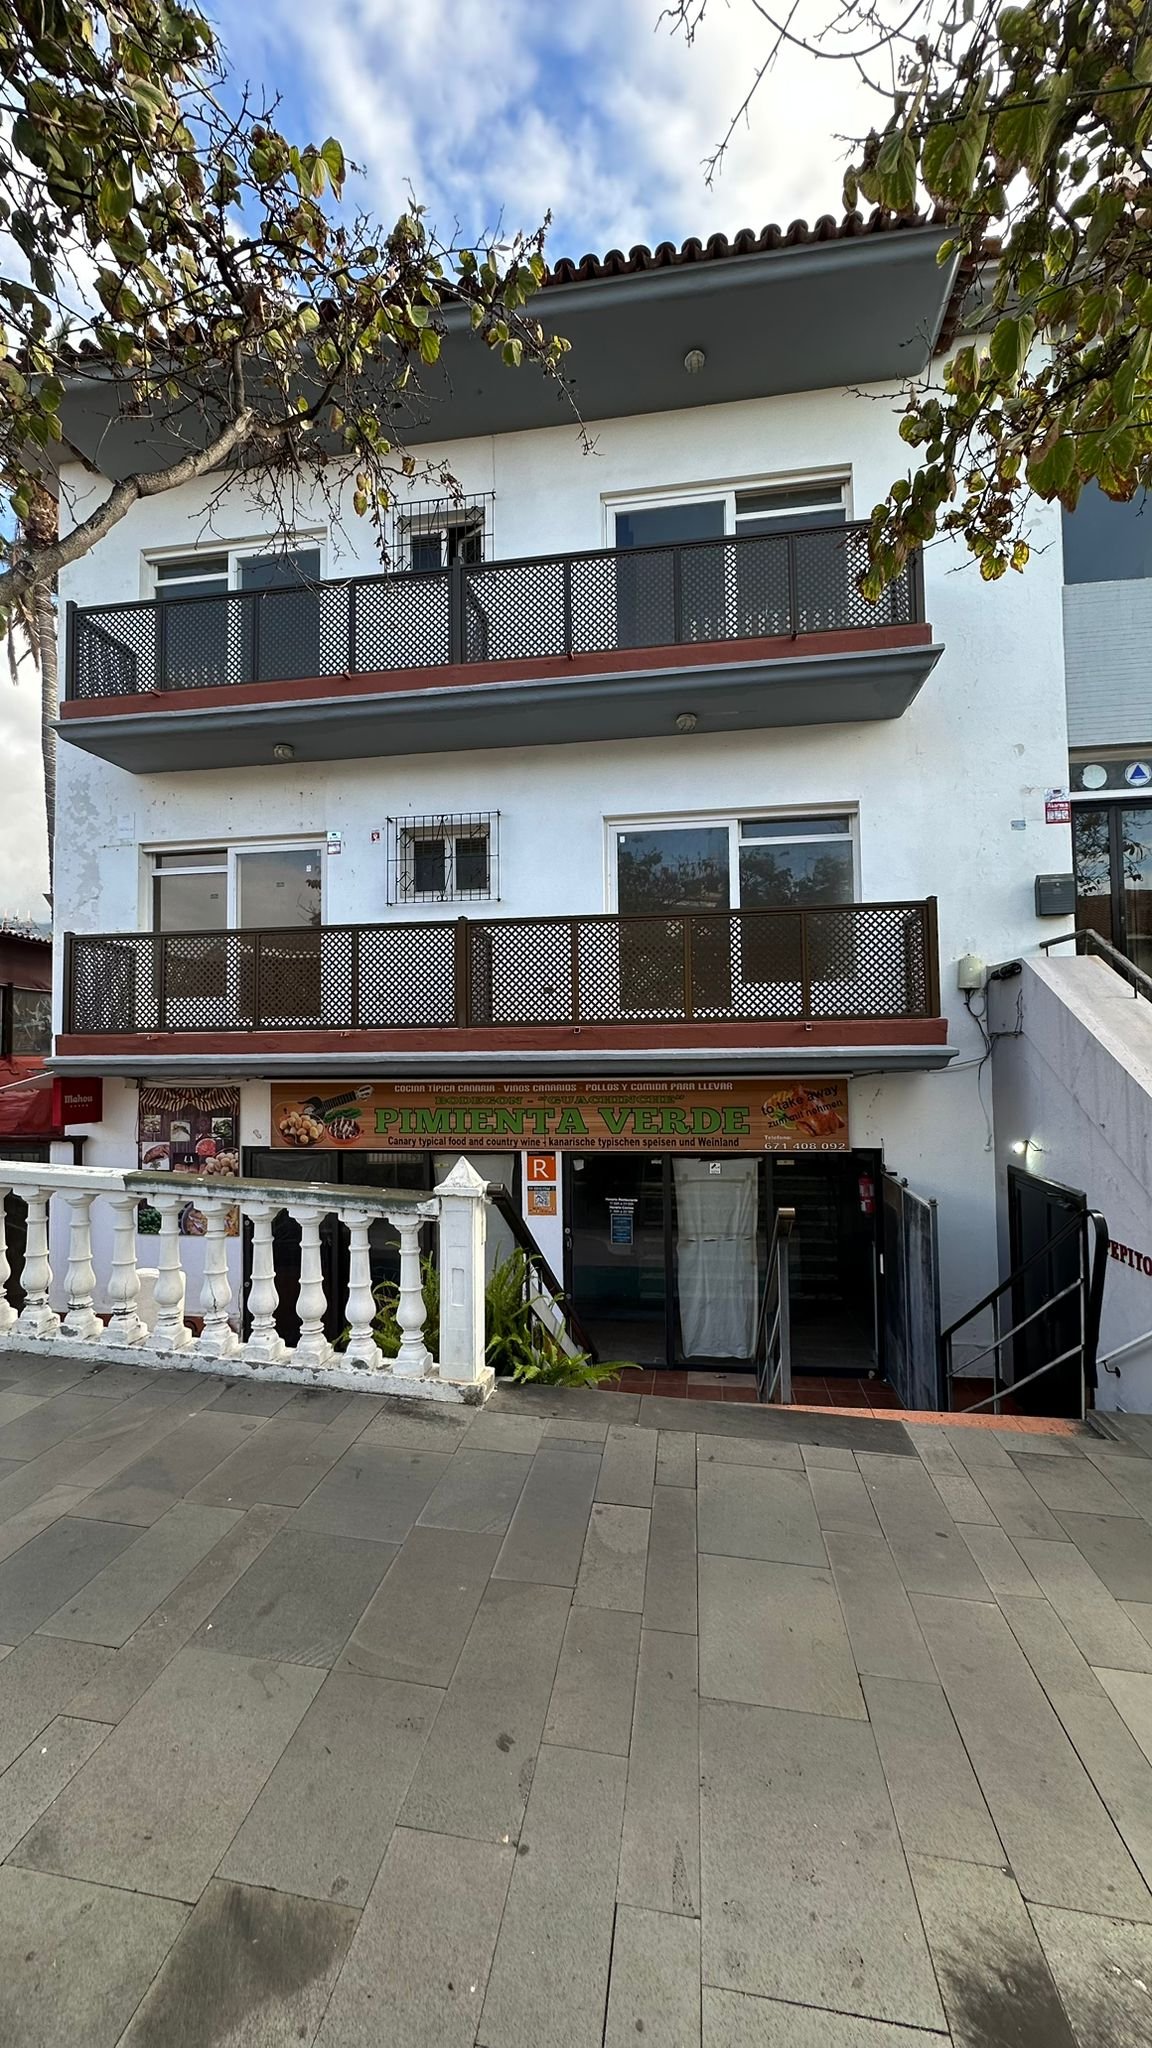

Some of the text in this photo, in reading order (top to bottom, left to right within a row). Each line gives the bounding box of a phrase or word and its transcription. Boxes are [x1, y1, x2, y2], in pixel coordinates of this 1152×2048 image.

[533, 1084, 576, 1092] CANARIOS
[64, 1094, 93, 1103] Mahou
[761, 1085, 838, 1115] to take away
[806, 1099, 843, 1116] nehmen
[374, 1107, 750, 1135] PIMIENTA VERDE
[388, 1137, 416, 1146] Canary
[419, 1136, 446, 1146] typical
[448, 1136, 466, 1145] food
[469, 1137, 483, 1145] and
[487, 1137, 518, 1146] country
[549, 1138, 595, 1146] kanarische
[598, 1138, 640, 1147] typischen
[643, 1138, 676, 1147] speisen
[679, 1138, 694, 1146] und
[698, 1137, 739, 1146] Weinland
[534, 1159, 549, 1178] R
